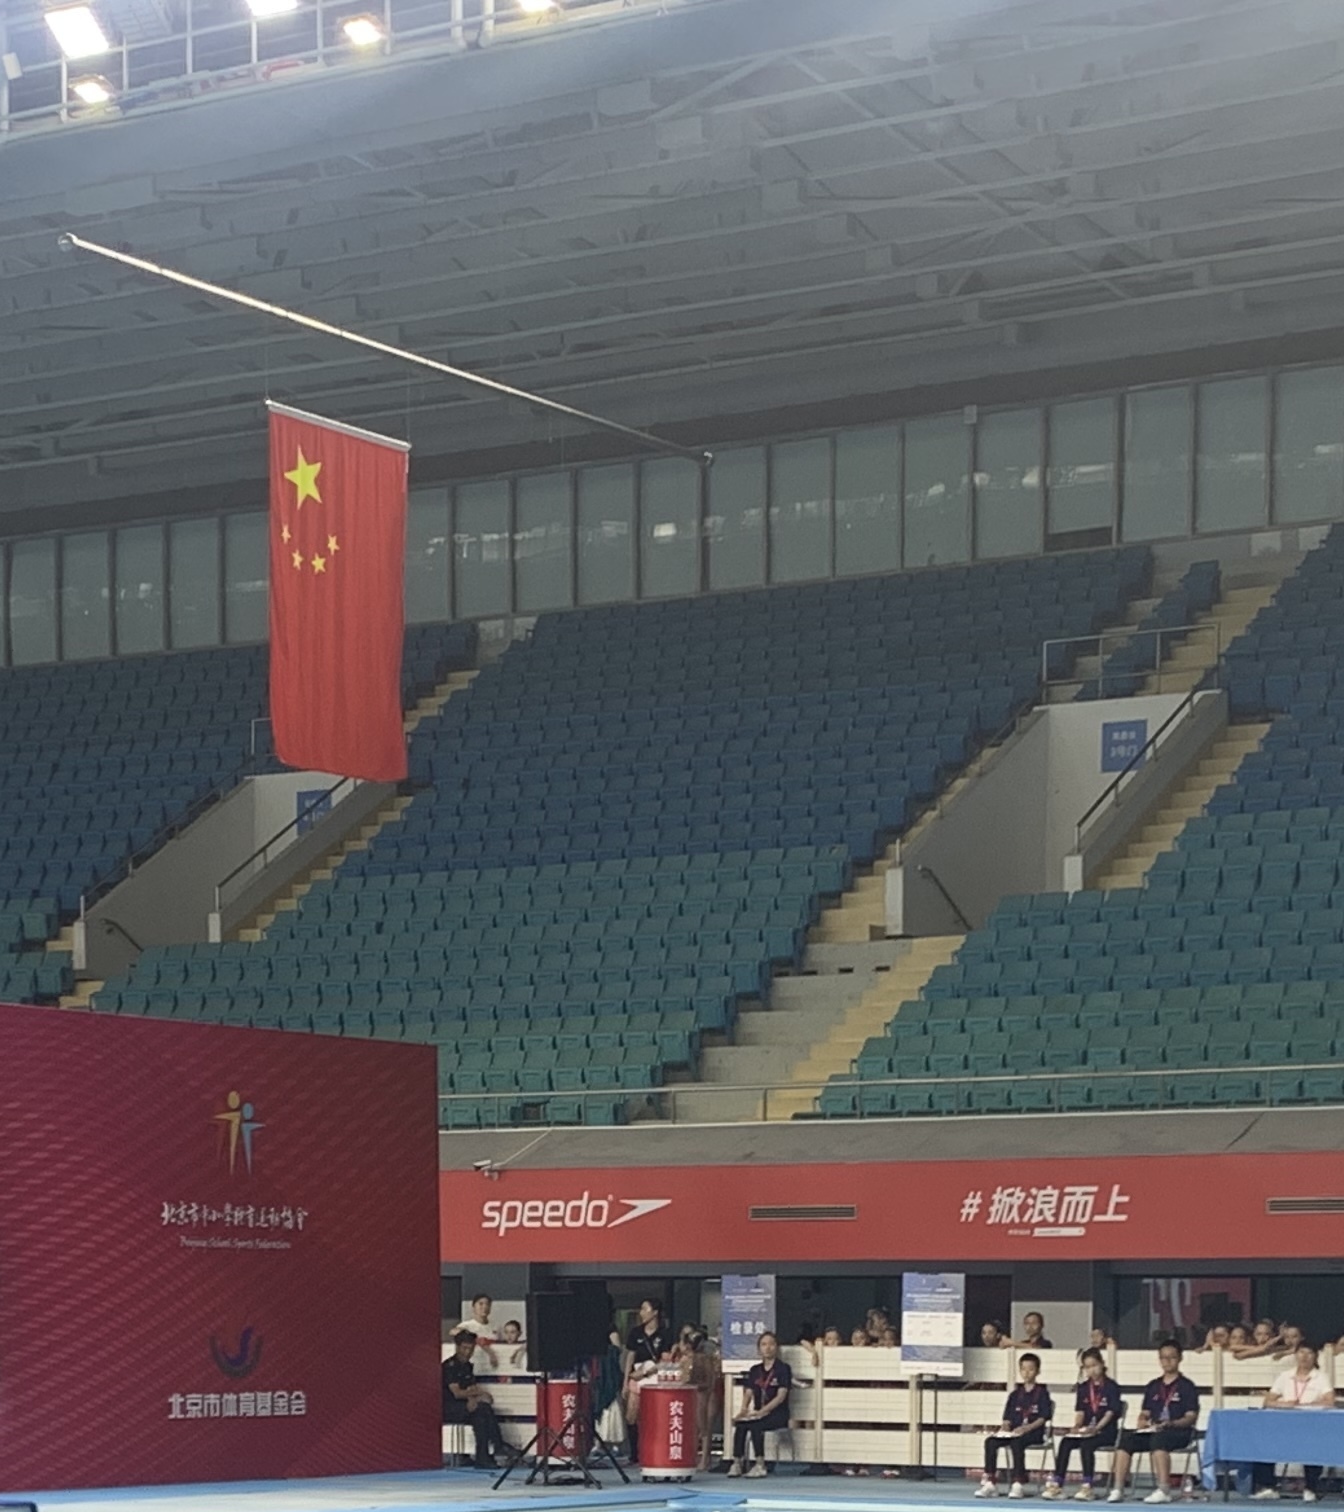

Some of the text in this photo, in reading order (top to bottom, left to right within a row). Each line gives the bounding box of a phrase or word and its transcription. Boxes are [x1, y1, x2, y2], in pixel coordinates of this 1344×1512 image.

[481, 1190, 609, 1237] speedo
[168, 1391, 307, 1420] 北京市体育基金会
[669, 1400, 684, 1460] 农夫山泉
